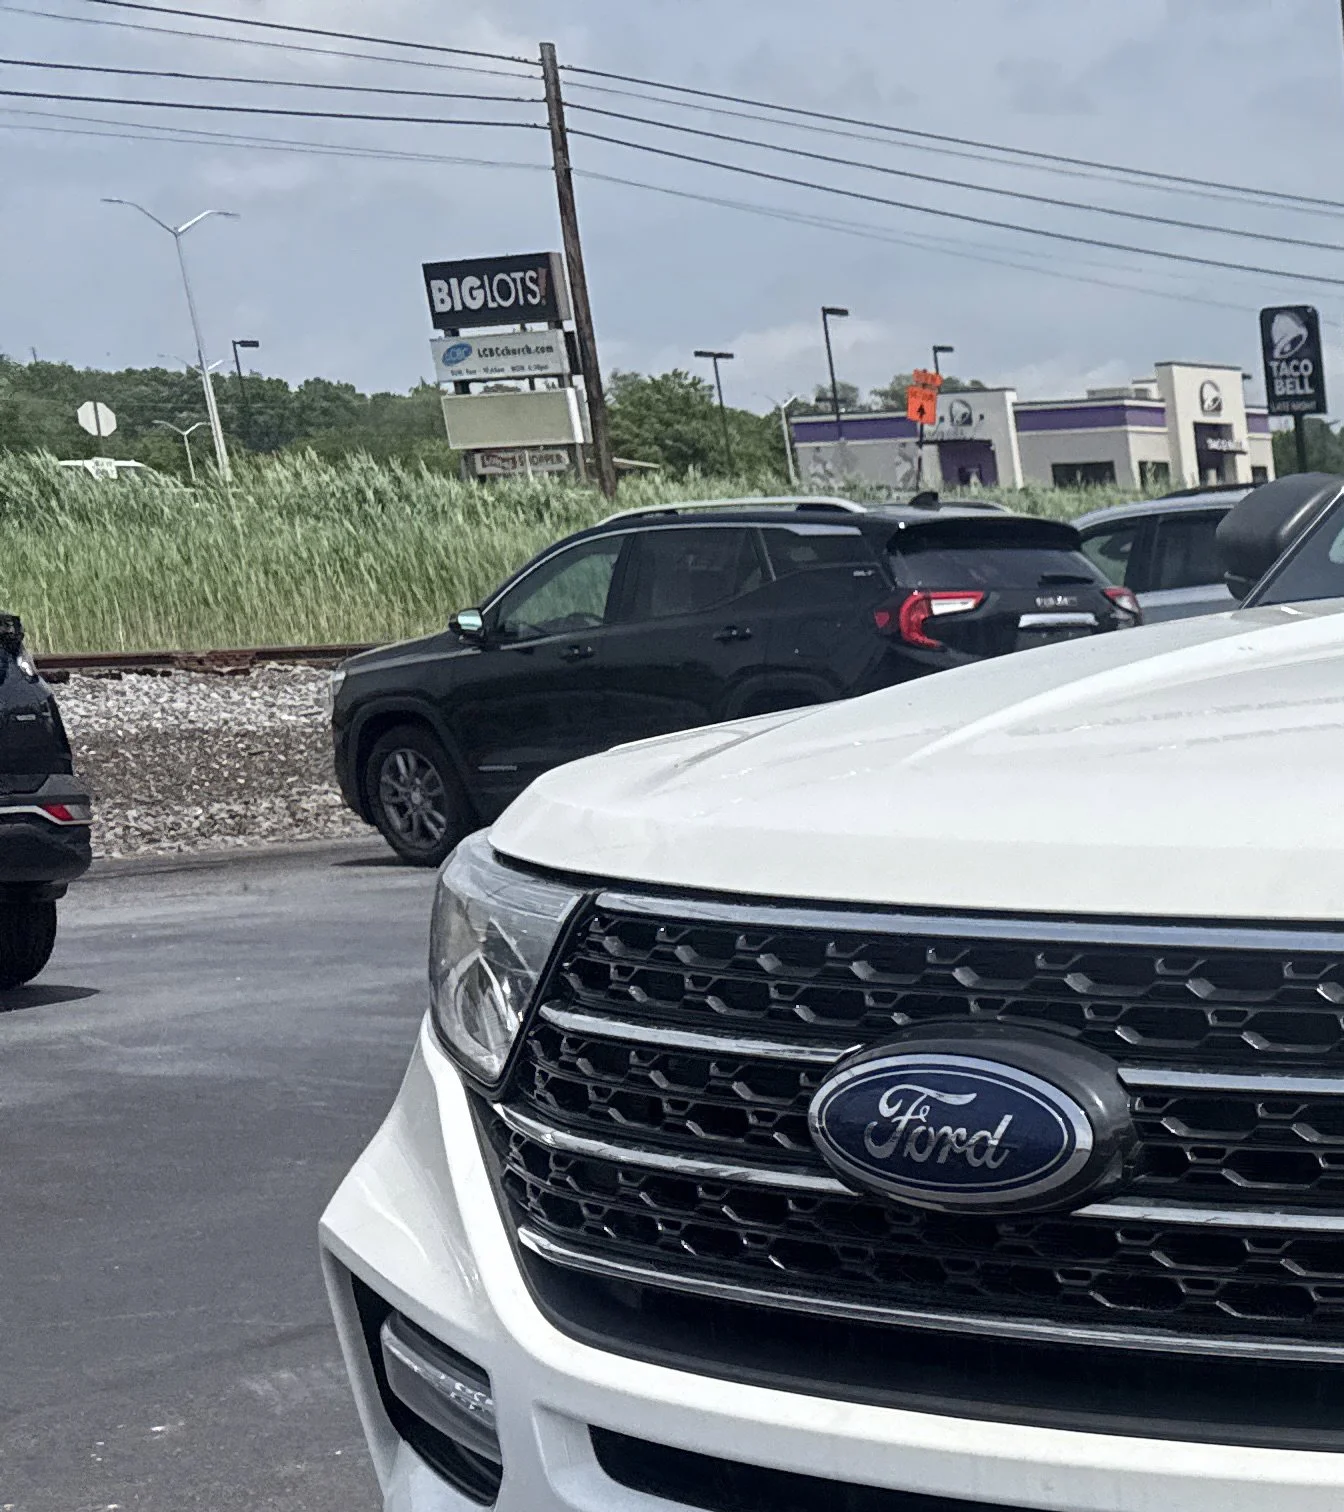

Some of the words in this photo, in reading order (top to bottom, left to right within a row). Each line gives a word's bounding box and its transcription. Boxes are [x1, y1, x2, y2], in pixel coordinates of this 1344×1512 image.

[1268, 358, 1313, 378] TACO
[1274, 376, 1315, 397] BELL
[863, 1083, 1015, 1169] Ford
